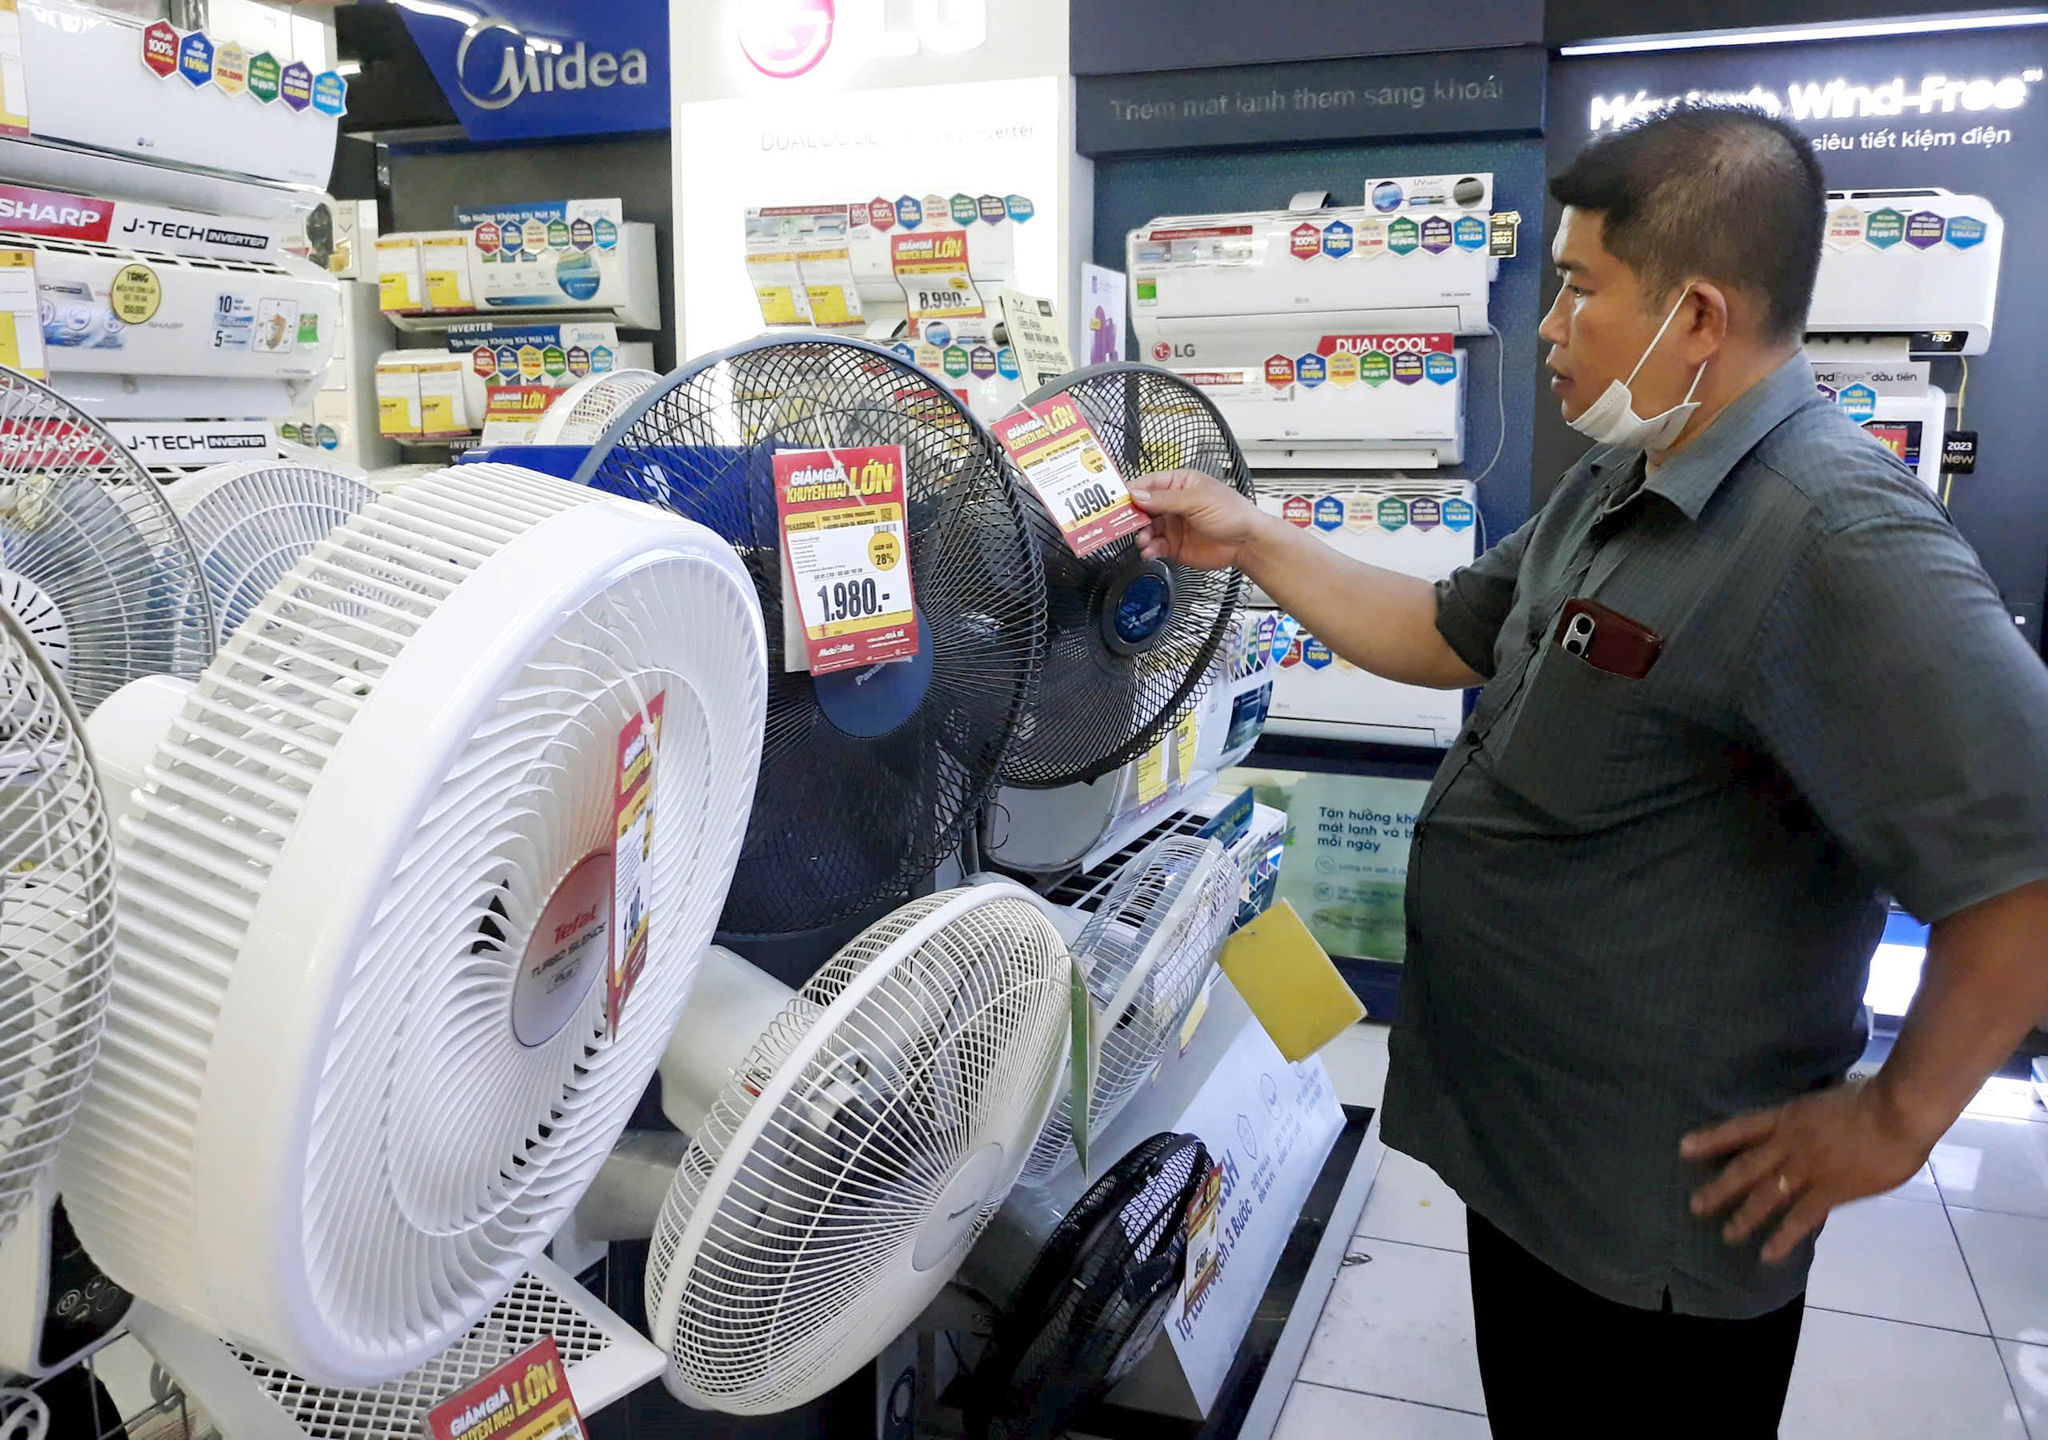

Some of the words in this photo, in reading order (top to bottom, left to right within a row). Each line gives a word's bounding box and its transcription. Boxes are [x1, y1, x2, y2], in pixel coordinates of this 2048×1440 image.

[148, 39, 175, 56] 100%
[457, 16, 648, 109] Midea
[1812, 133, 1854, 152] siêu
[1859, 127, 1897, 149] tiết
[1901, 129, 1956, 151] kiệm
[1961, 126, 2011, 149] điện
[0, 198, 101, 228] SHARP
[122, 218, 205, 241] J-TECH
[208, 230, 268, 249] INVERTER
[218, 295, 232, 313] 10
[214, 330, 223, 347] 5
[448, 323, 493, 333] INVERTER
[1174, 344, 1196, 358] LG
[127, 435, 206, 450] J-TECH
[209, 436, 267, 449] INVERTER
[1947, 441, 1973, 451] 2023
[1942, 453, 1975, 465] New
[790, 464, 823, 487] GIẢM
[848, 458, 894, 497] LỚN
[875, 553, 895, 566] 28%
[817, 577, 890, 622] 1.980.-
[1346, 839, 1381, 853] ngày
[554, 903, 597, 945] Tefal
[531, 948, 566, 978] TURBO
[568, 921, 607, 955] SILENCE
[1225, 1227, 1236, 1250] 3
[1231, 1197, 1254, 1239] Bước
[512, 1358, 558, 1417] LỚN
